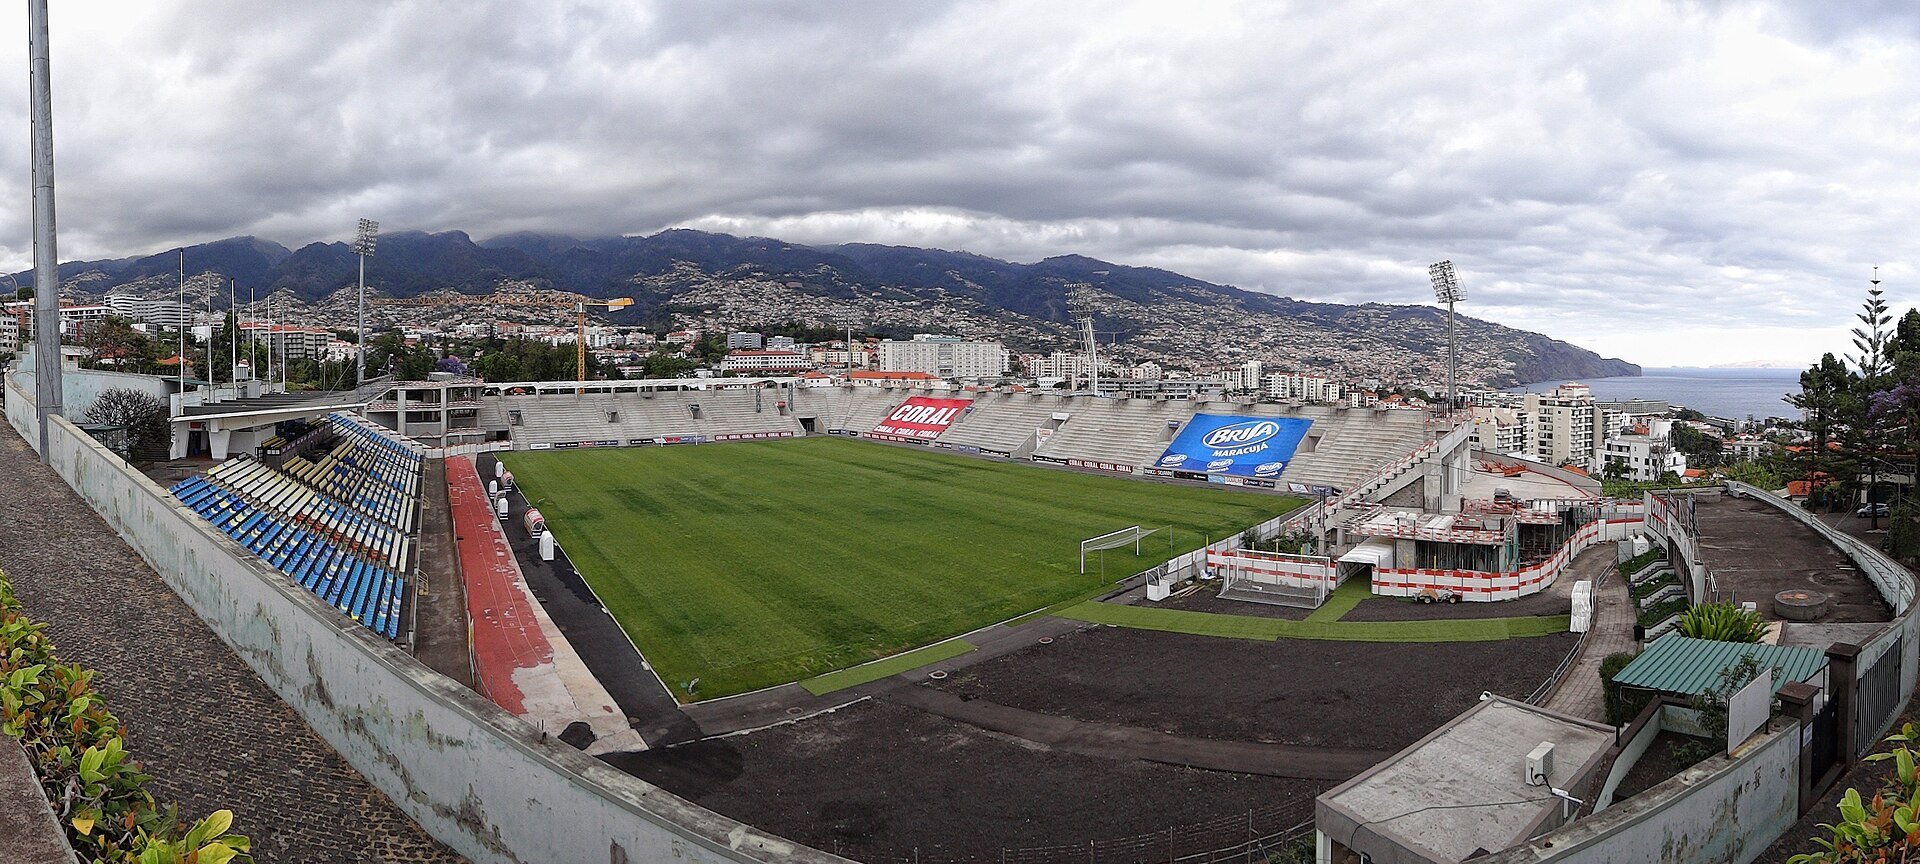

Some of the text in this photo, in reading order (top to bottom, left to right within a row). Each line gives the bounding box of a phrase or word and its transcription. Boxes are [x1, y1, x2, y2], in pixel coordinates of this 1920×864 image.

[891, 405, 958, 425] CORAL
[1208, 422, 1273, 445] BRISA
[1212, 442, 1269, 457] MARACUJÁ
[1084, 461, 1099, 469] CORAL
[1100, 463, 1115, 471] CORAL
[1116, 464, 1132, 472] CORAL
